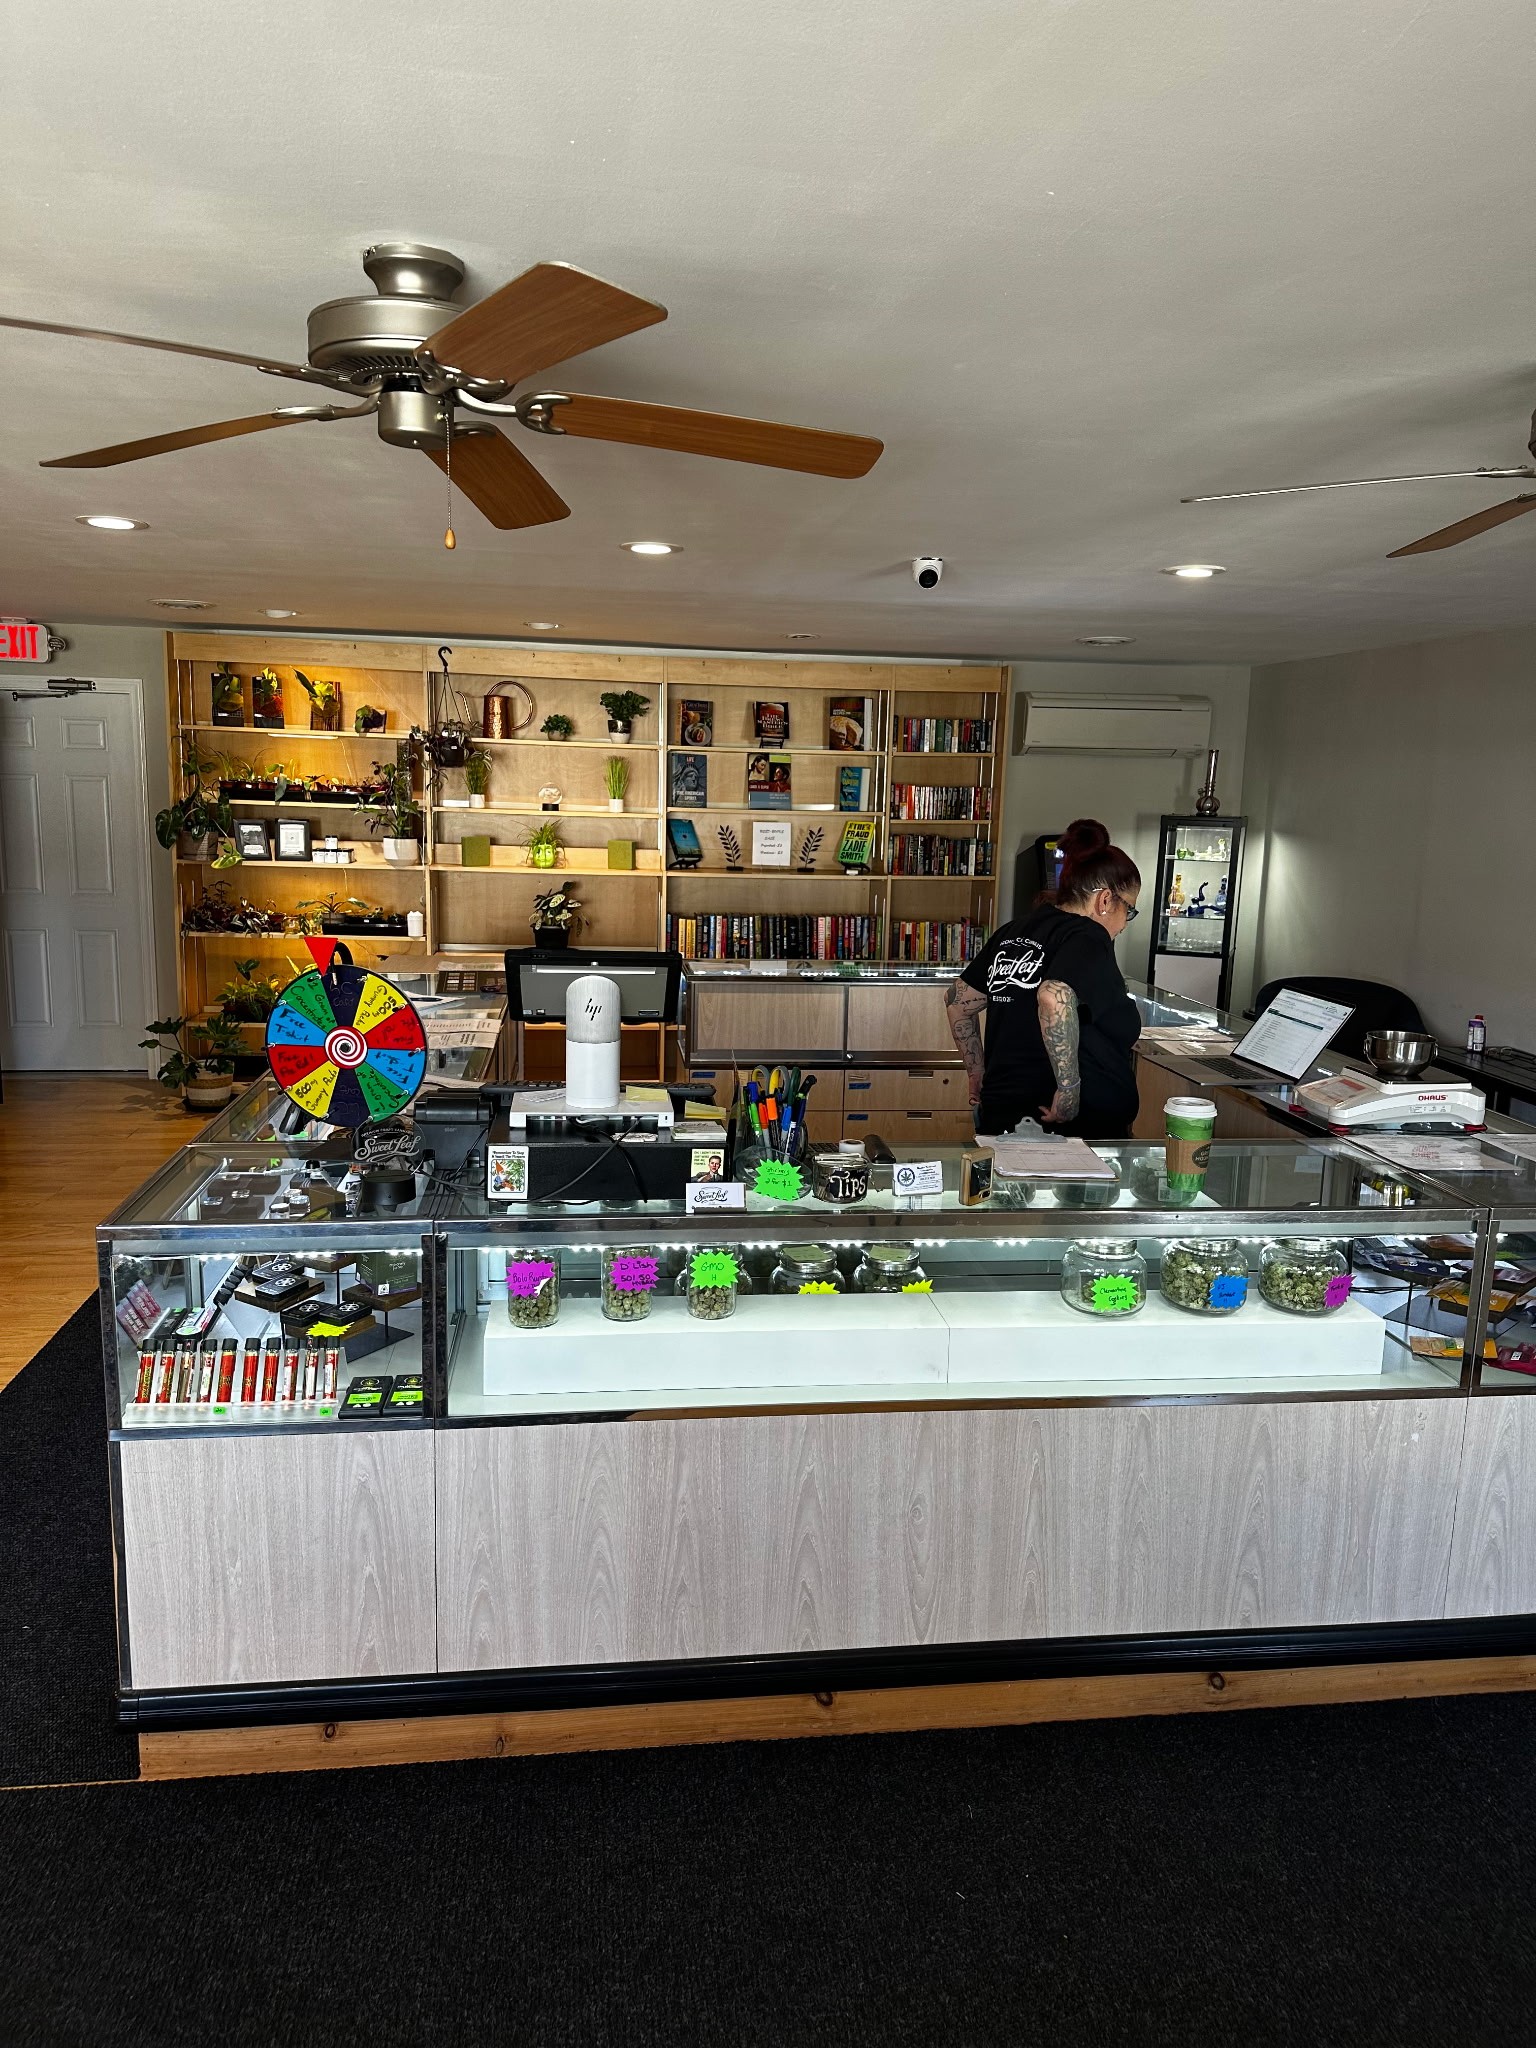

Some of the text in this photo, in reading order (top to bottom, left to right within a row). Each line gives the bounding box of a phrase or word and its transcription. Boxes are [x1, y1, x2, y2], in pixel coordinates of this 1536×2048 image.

[0, 625, 39, 659] EXIT
[846, 830, 870, 838] FRAUD
[842, 839, 868, 853] ZADIE
[840, 851, 865, 862] SMITH
[585, 998, 602, 1021] hp
[279, 1007, 306, 1029] Free
[354, 1134, 422, 1161] Sweet Leaf
[782, 1178, 793, 1188] $1
[694, 1190, 716, 1203] Sweet
[711, 1273, 717, 1281] H
